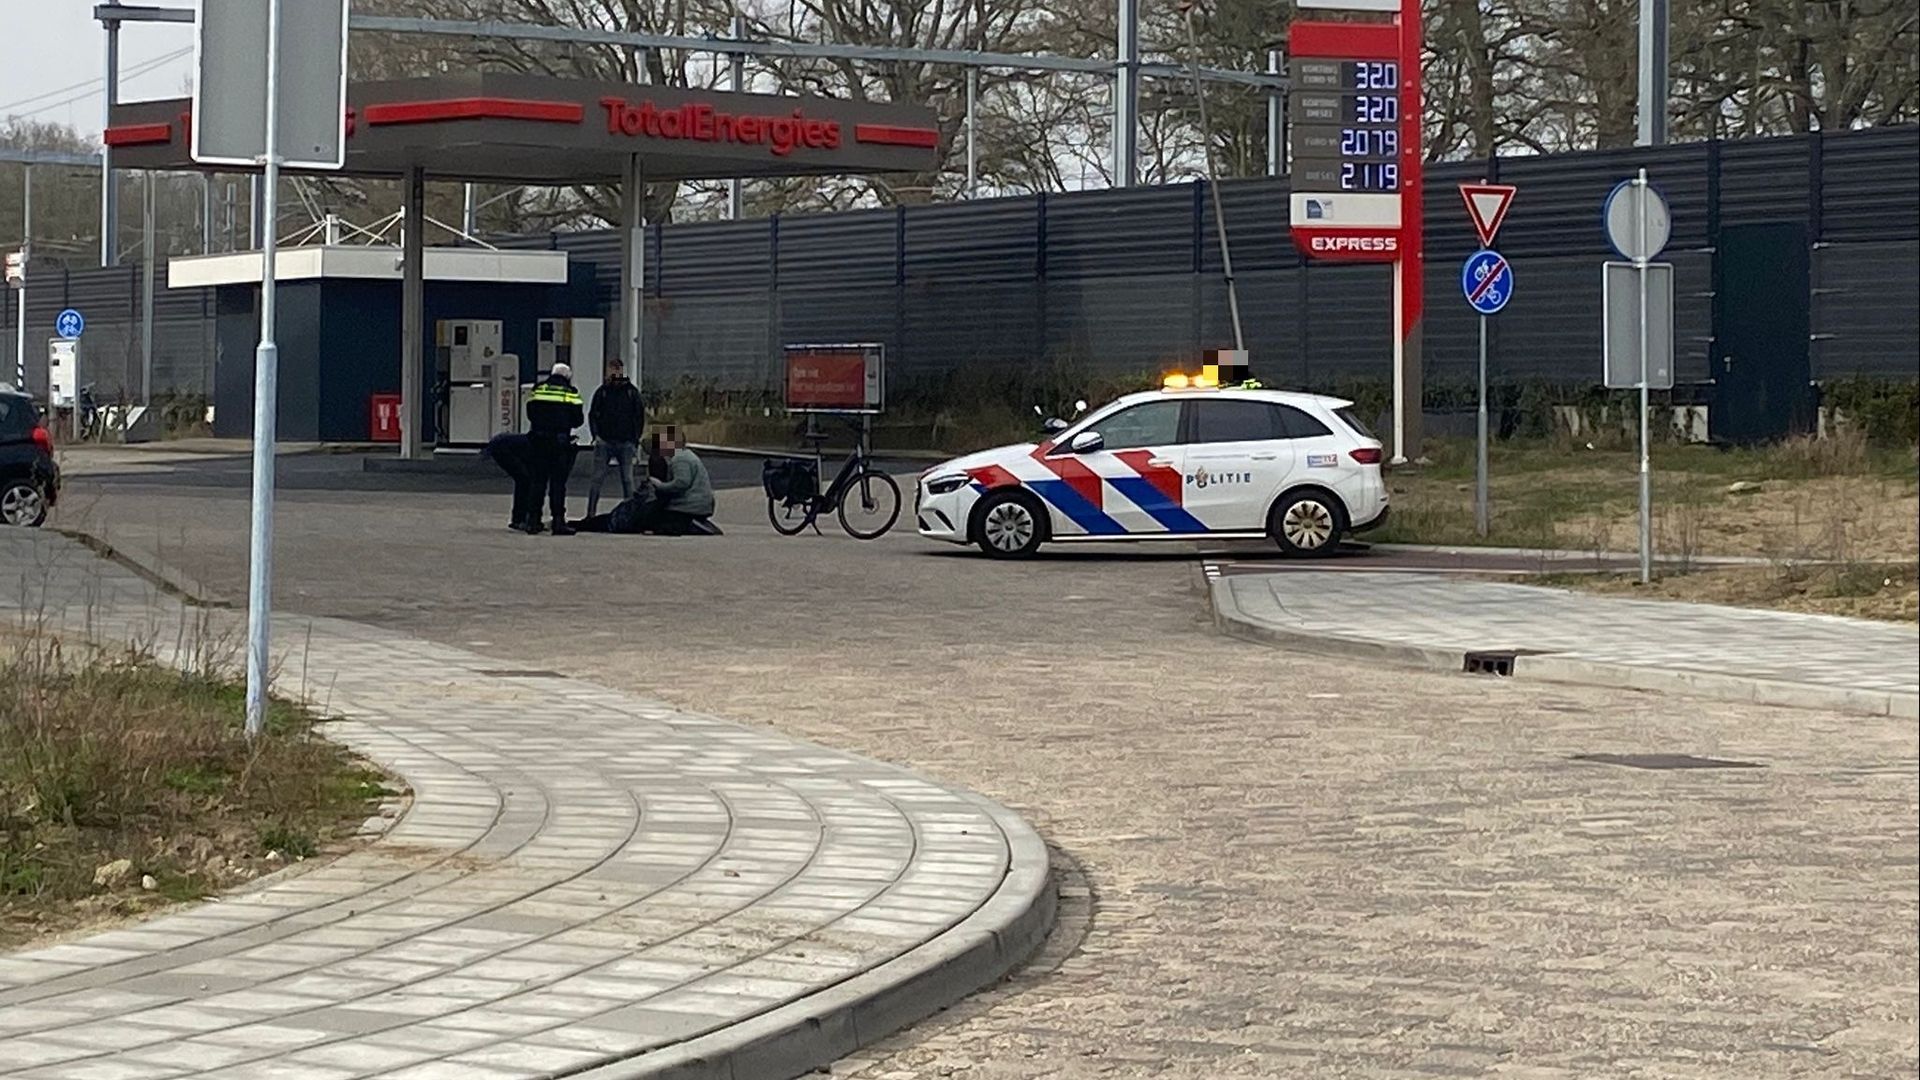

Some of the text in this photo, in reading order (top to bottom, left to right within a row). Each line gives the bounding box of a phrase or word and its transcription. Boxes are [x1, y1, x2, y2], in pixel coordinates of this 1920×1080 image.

[601, 96, 841, 156] TotalEnergies
[1311, 237, 1397, 251] EXPRESS
[1186, 471, 1251, 488] POLITIE
